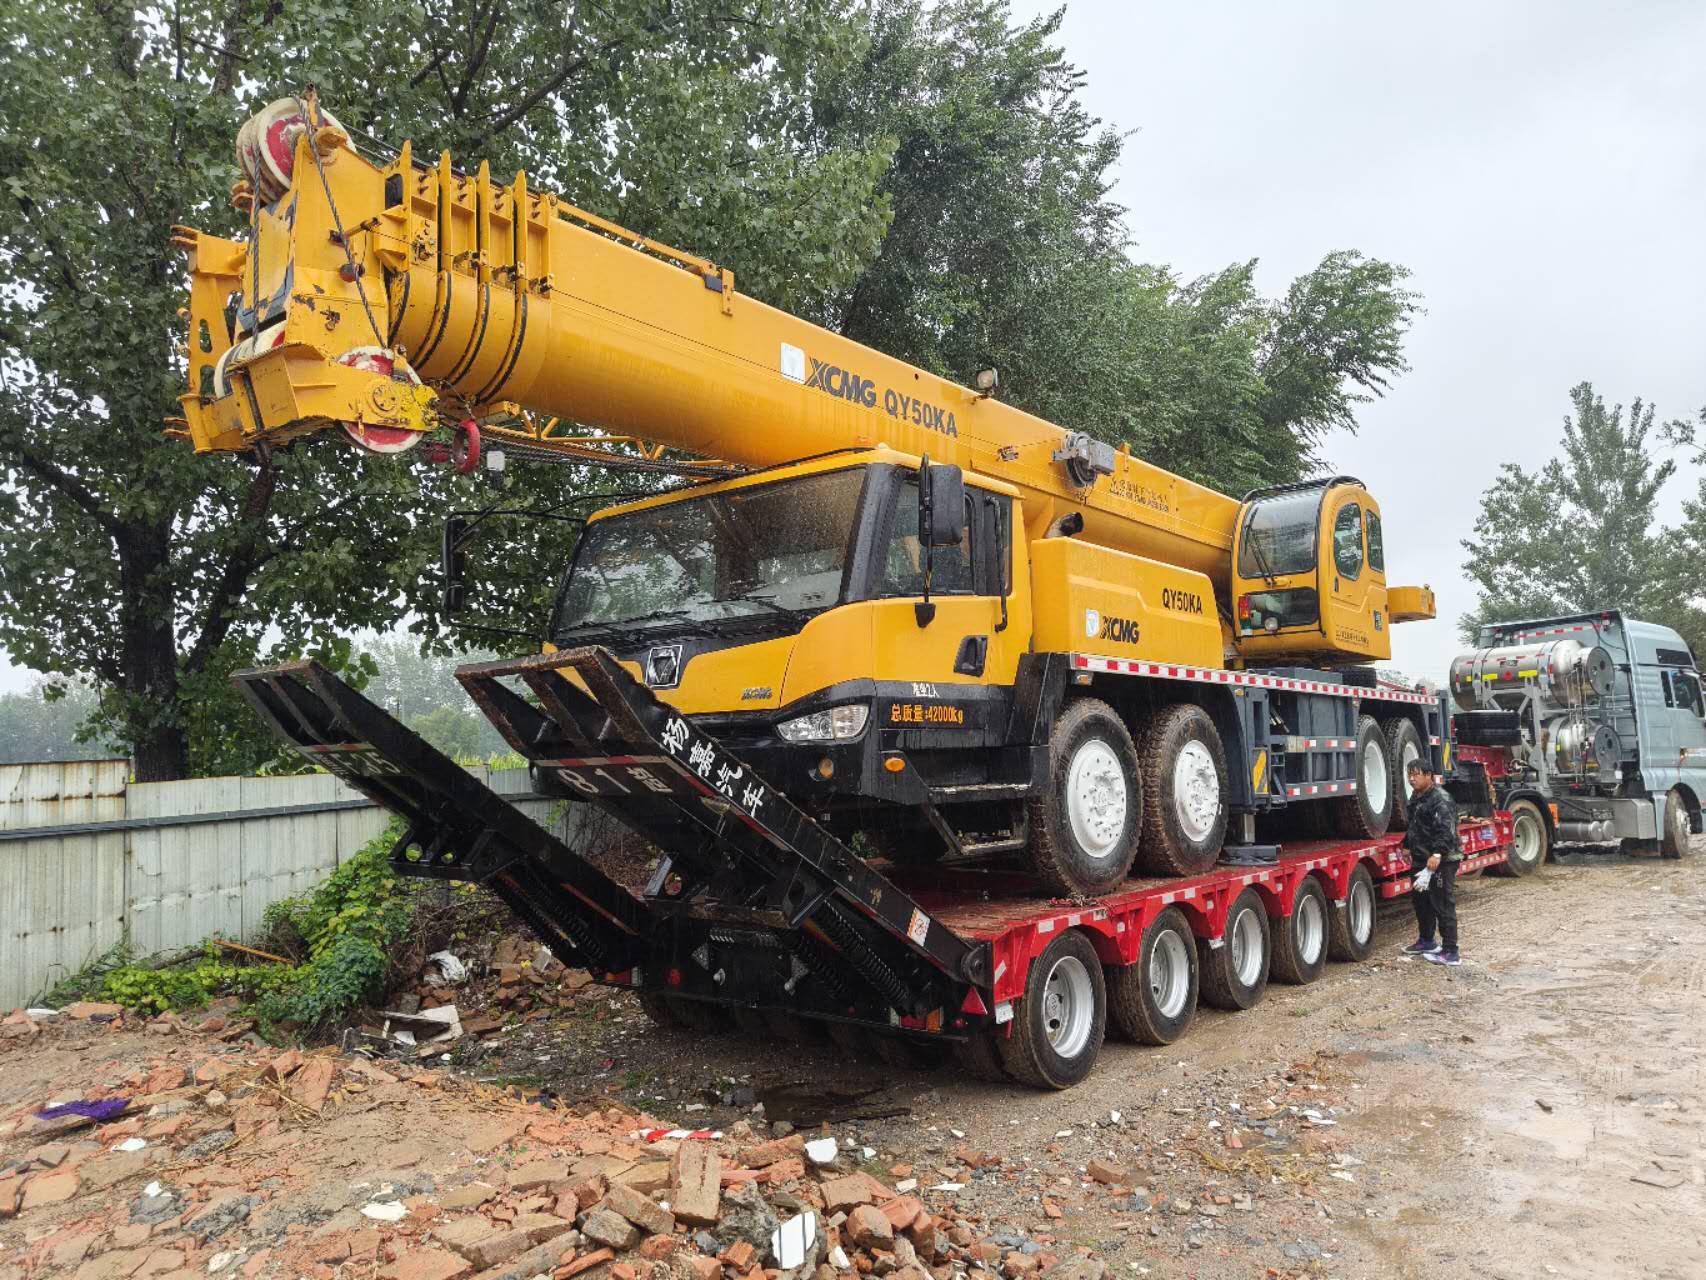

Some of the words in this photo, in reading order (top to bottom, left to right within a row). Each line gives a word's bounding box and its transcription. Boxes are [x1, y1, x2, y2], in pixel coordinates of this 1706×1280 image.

[805, 357, 876, 408] XCMG
[884, 388, 958, 438] QY50KA
[1162, 588, 1203, 614] QY50KA
[1100, 616, 1140, 644] XCMG
